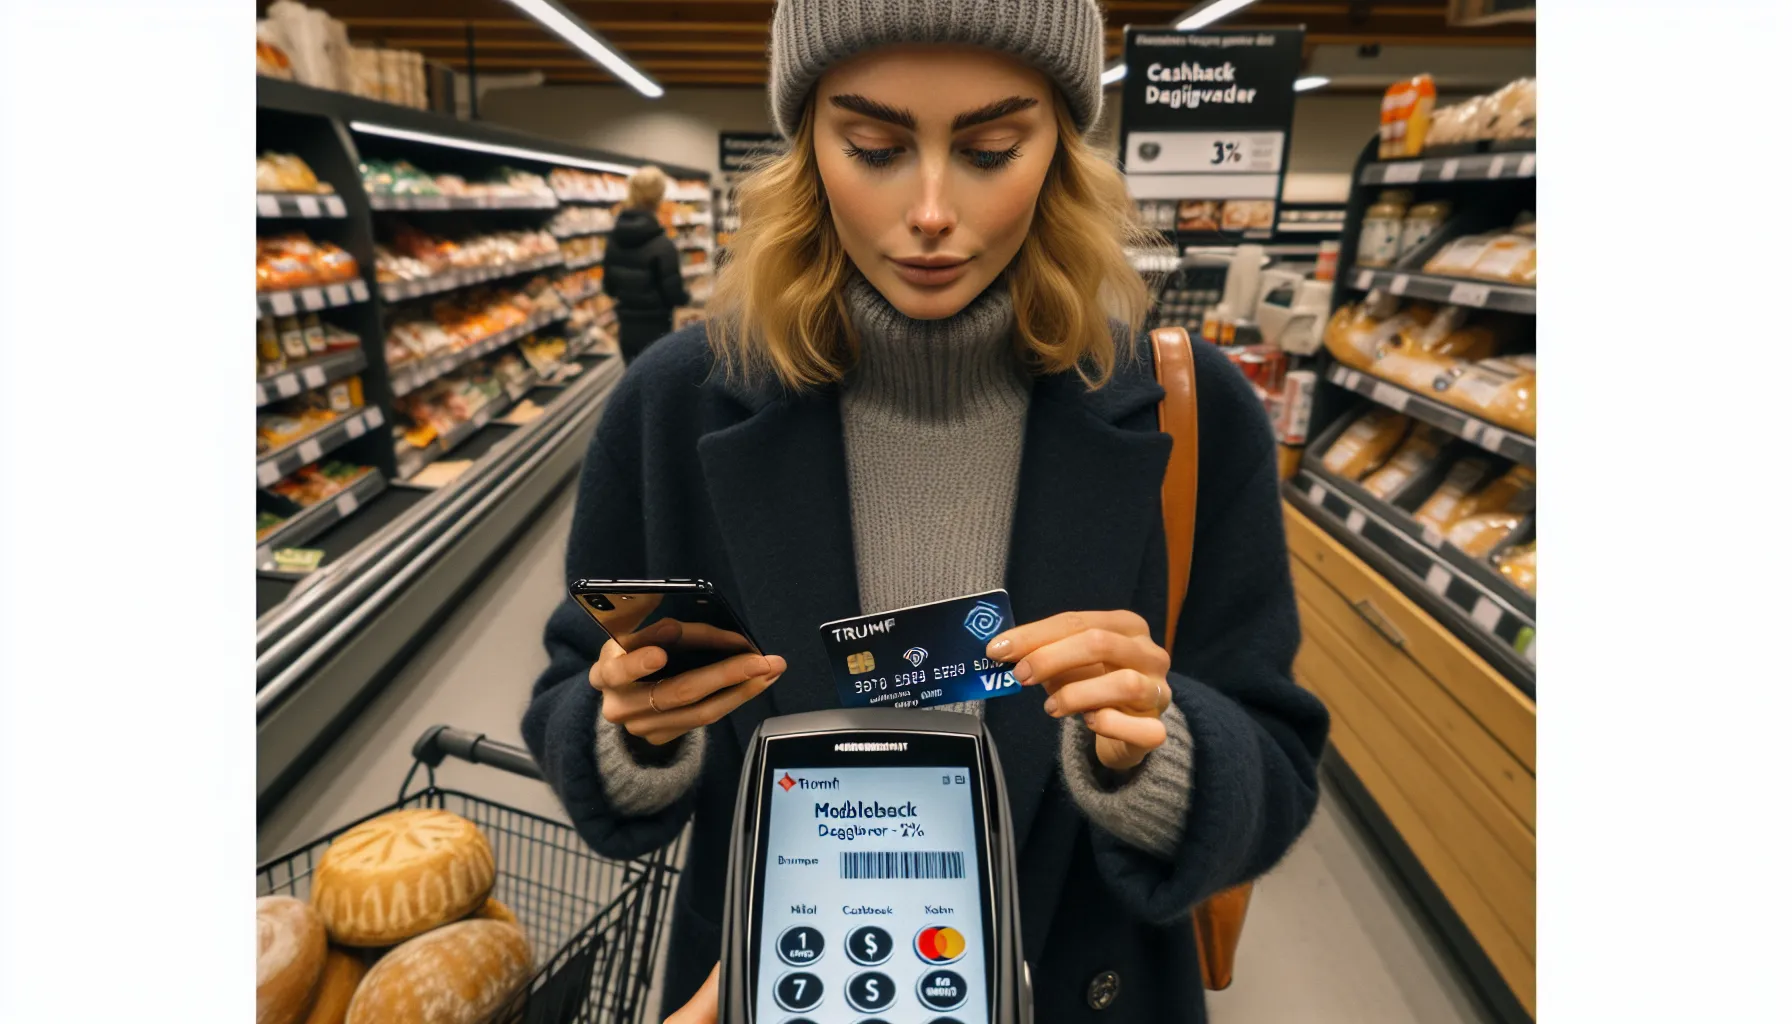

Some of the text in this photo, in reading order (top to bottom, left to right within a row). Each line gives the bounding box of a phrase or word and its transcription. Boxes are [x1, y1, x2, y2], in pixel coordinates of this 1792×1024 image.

[1210, 141, 1242, 165] 3%
[798, 932, 807, 949] 1
[793, 979, 807, 1001] 7
